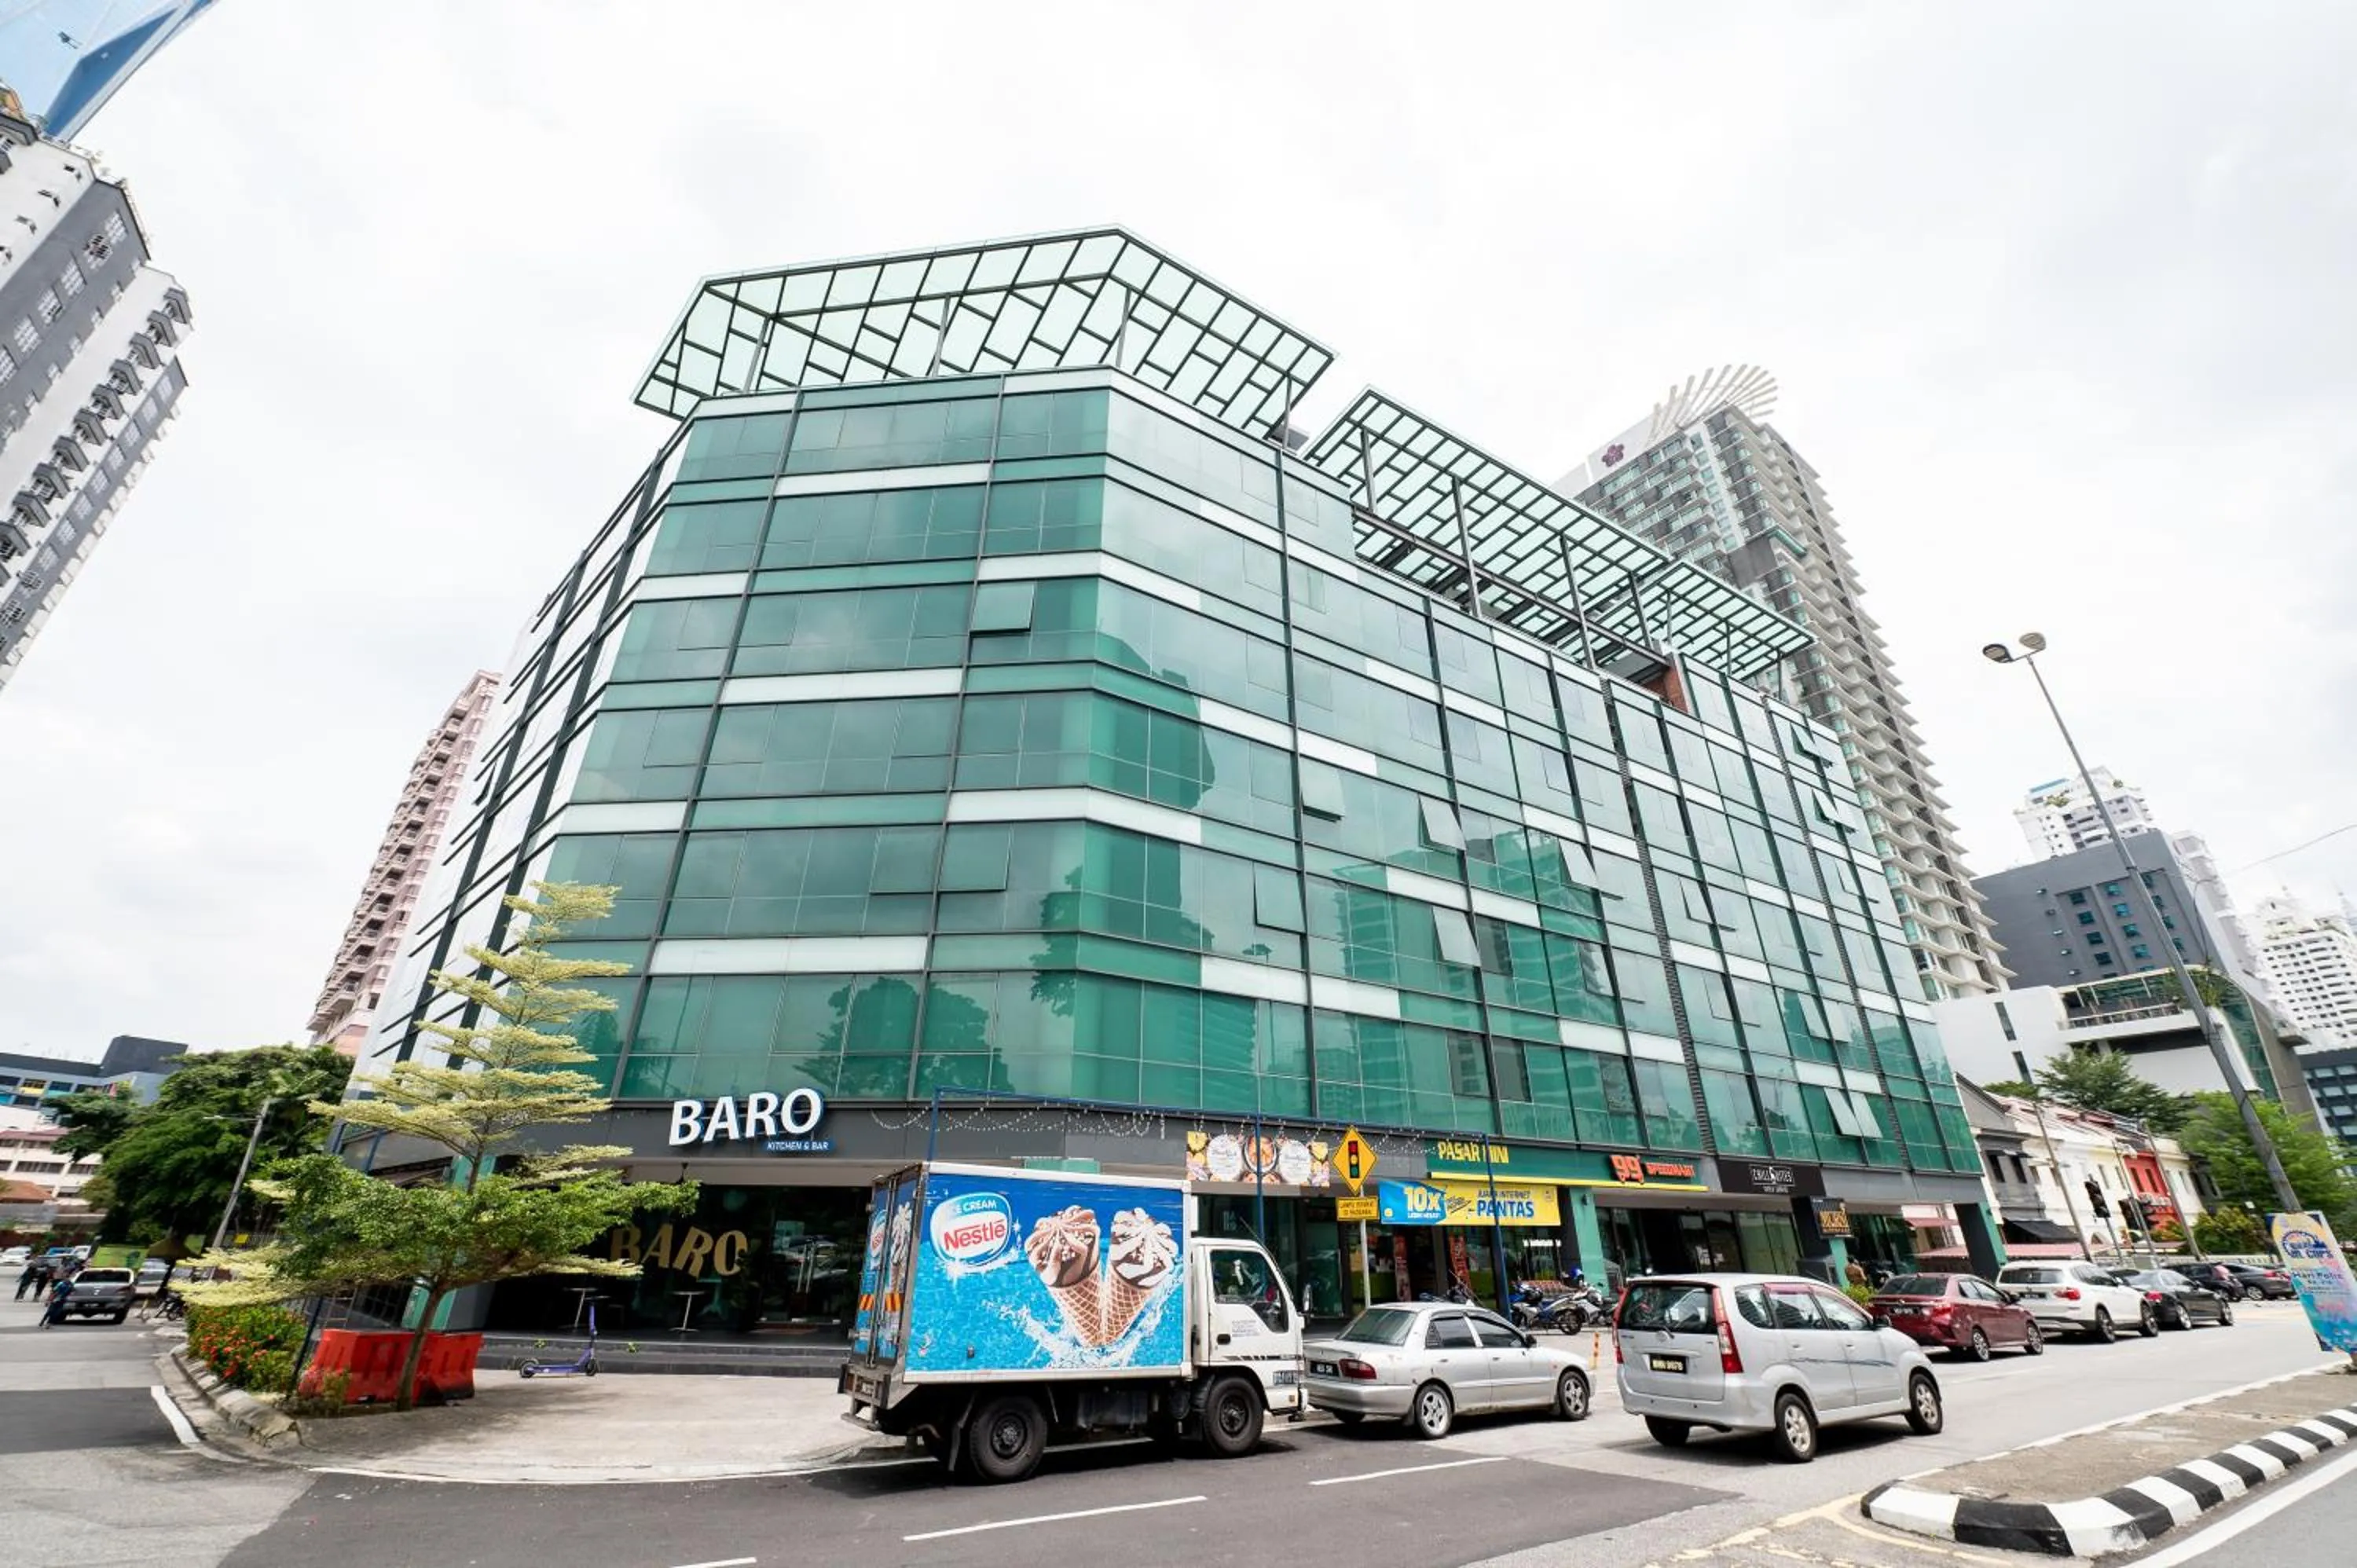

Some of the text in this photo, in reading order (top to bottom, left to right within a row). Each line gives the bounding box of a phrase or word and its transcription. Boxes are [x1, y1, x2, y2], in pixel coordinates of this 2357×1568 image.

[669, 1088, 821, 1145] BARO
[767, 1141, 801, 1150] KITCHEN
[811, 1141, 829, 1150] BAR
[1438, 1141, 1480, 1161] PASAR
[1610, 1154, 1644, 1184] 99
[962, 1200, 996, 1211] CREAM
[1477, 1200, 1534, 1218] PANTAS
